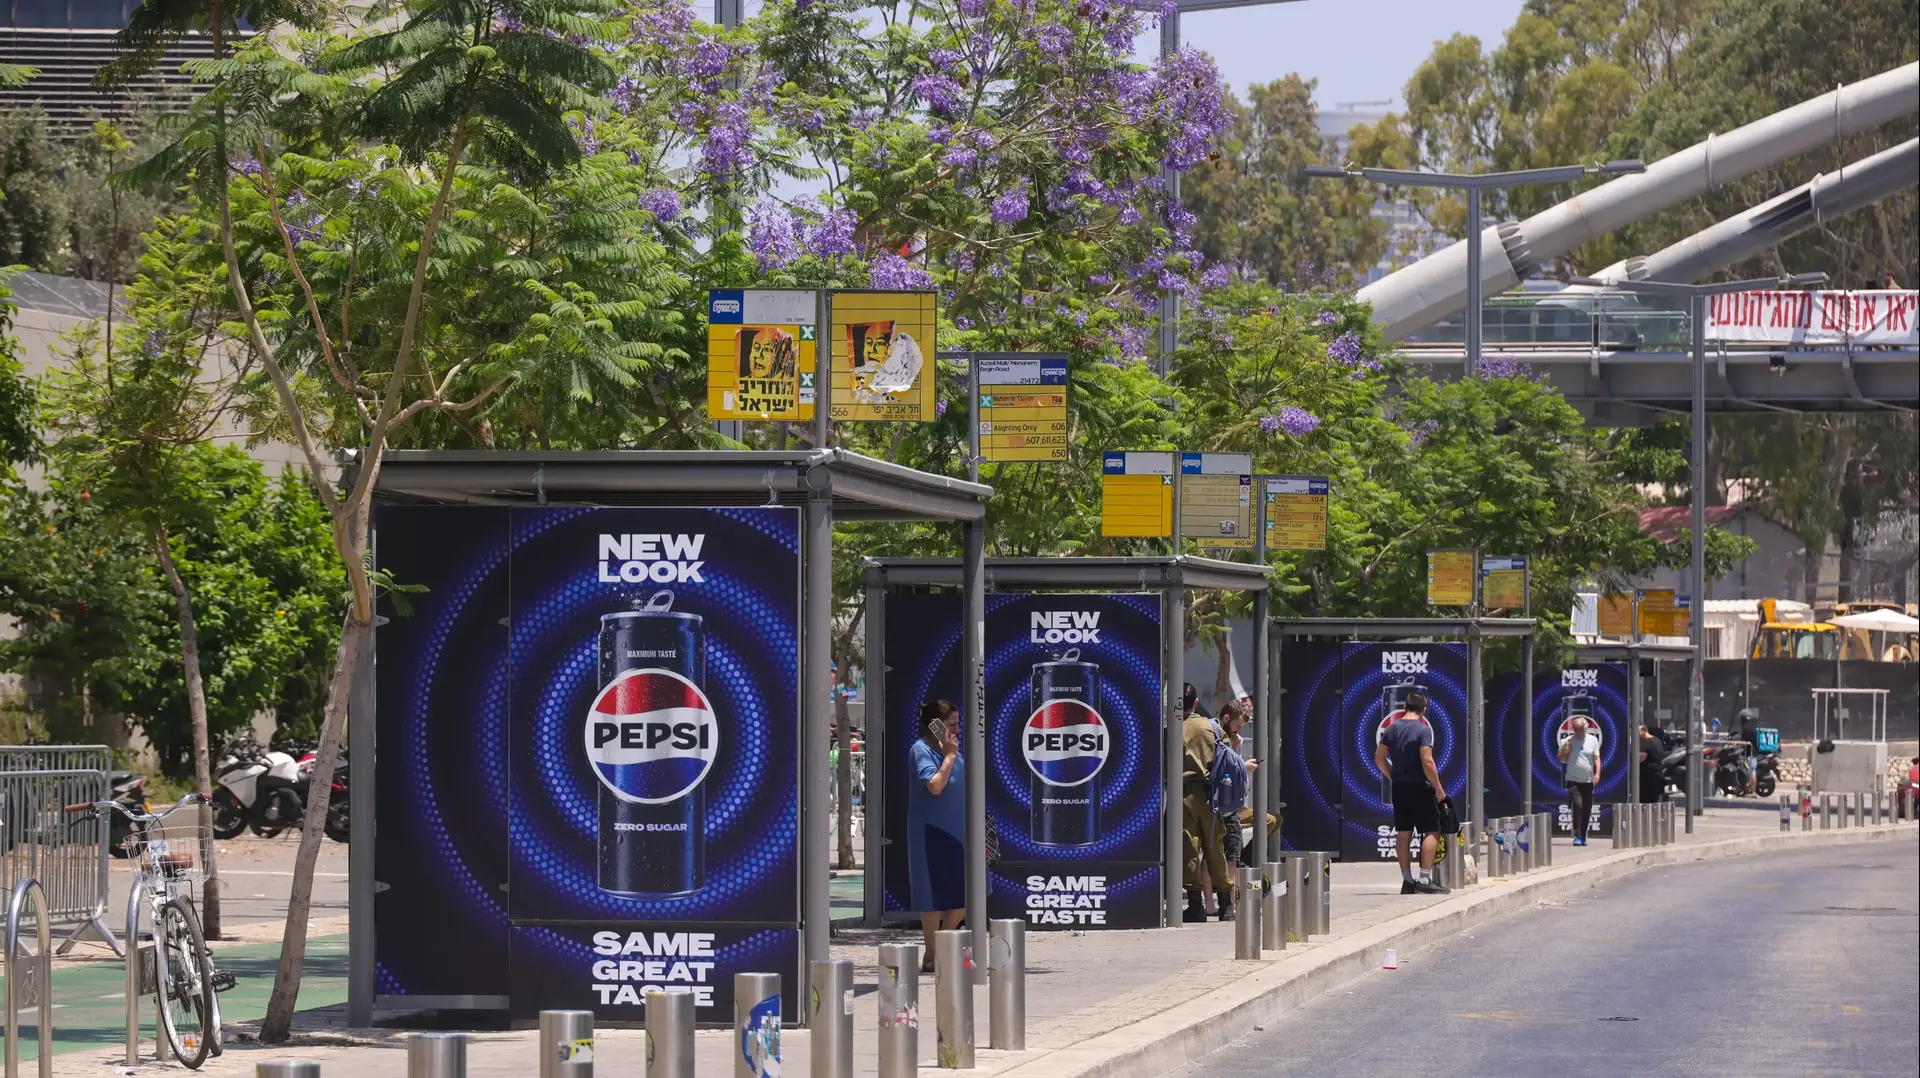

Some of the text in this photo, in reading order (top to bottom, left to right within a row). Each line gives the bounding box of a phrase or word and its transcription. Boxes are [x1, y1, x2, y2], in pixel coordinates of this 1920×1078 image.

[1710, 291, 1812, 328] מהגיהנום!
[1822, 294, 1876, 331] אותם
[738, 394, 794, 412] ישראל
[873, 404, 919, 414] תל אביב יפו
[831, 407, 848, 417] 566
[993, 424, 1021, 432] Alighting
[1022, 424, 1038, 432] Only
[1051, 423, 1066, 431] 606
[1051, 450, 1066, 458] 650
[598, 533, 706, 560] NEW
[598, 560, 706, 583] LOOK
[1031, 611, 1100, 629] NEW
[1031, 629, 1100, 644] LOOK
[626, 650, 677, 658] MAXIMUM TASTE
[1382, 651, 1429, 663] NEW
[1382, 663, 1429, 673] LOOK
[1561, 669, 1598, 679] NEW
[1561, 679, 1598, 688] LOOK
[594, 722, 709, 750] PEPSI
[1028, 733, 1104, 752] PEPSI
[1558, 804, 1601, 813] SE
[614, 822, 688, 831] ZERO SUGAR
[1558, 822, 1601, 831] TAE
[1377, 837, 1421, 847] GRA
[1377, 848, 1421, 858] TAT
[1026, 875, 1107, 892] SAME
[1026, 894, 1107, 908] GREAT
[1026, 910, 1107, 925] TASTE
[592, 930, 716, 957] SAME
[592, 959, 715, 982] GREAT
